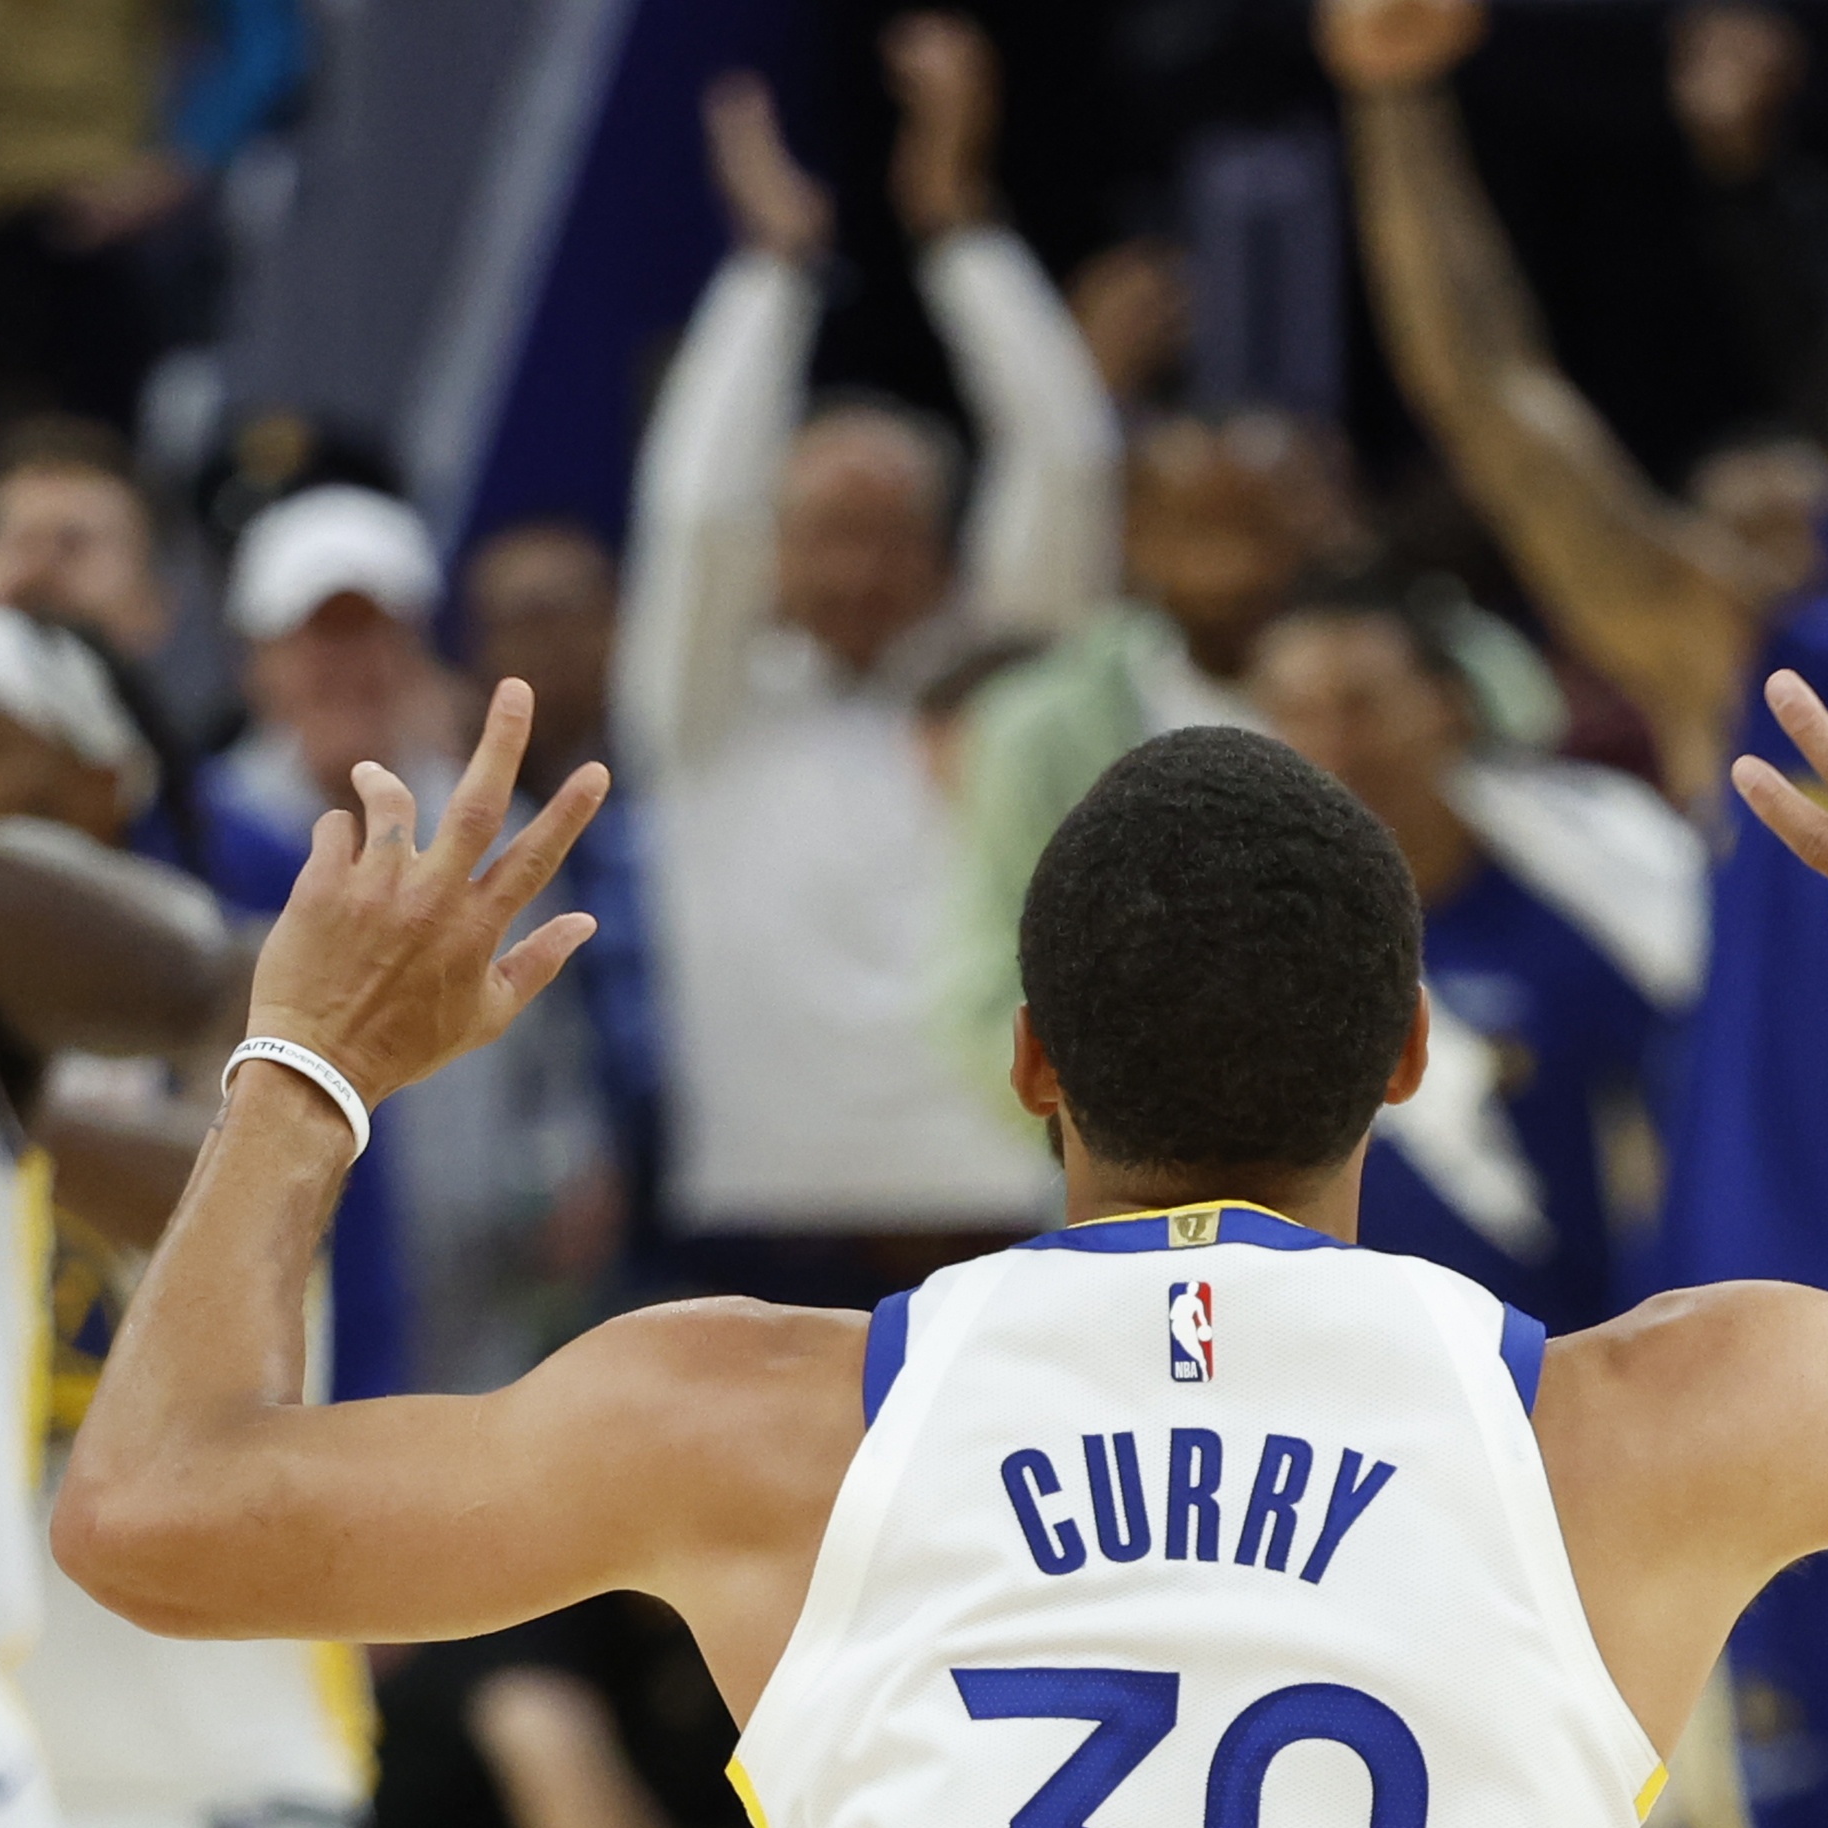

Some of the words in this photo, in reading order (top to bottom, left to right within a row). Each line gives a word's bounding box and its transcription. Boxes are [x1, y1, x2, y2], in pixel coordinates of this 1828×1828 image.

[284, 1049, 315, 1067] OVER
[315, 1063, 352, 1101] FEAR
[1174, 1361, 1199, 1379] NBA
[1000, 1427, 1397, 1585] CURRY
